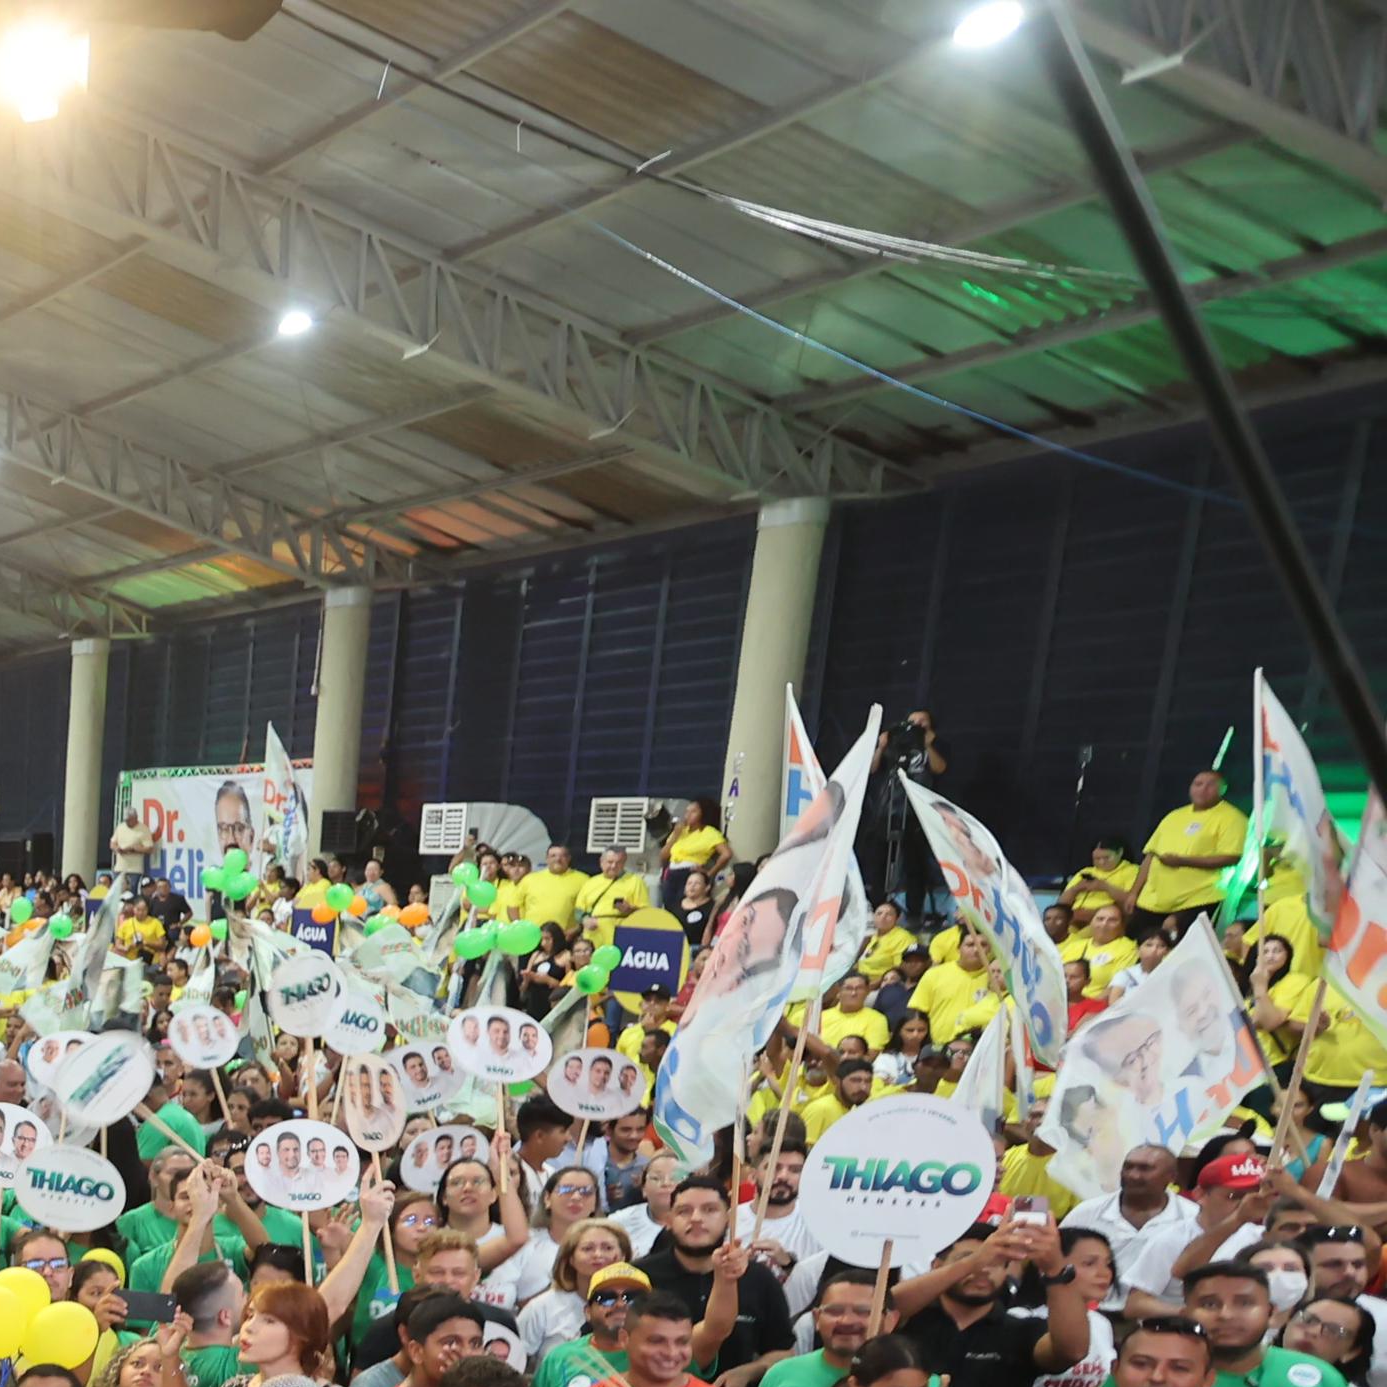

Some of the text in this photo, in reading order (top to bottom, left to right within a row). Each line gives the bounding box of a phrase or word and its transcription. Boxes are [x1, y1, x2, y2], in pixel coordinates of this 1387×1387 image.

[143, 798, 185, 843] Dr.
[295, 923, 327, 942] ÁGUA
[621, 946, 670, 971] ÁGUA
[26, 1167, 115, 1201] THIAGO
[825, 1156, 983, 1196] THIAGO
[287, 1192, 322, 1202] THIAGO
[846, 1196, 941, 1208] MENEZES
